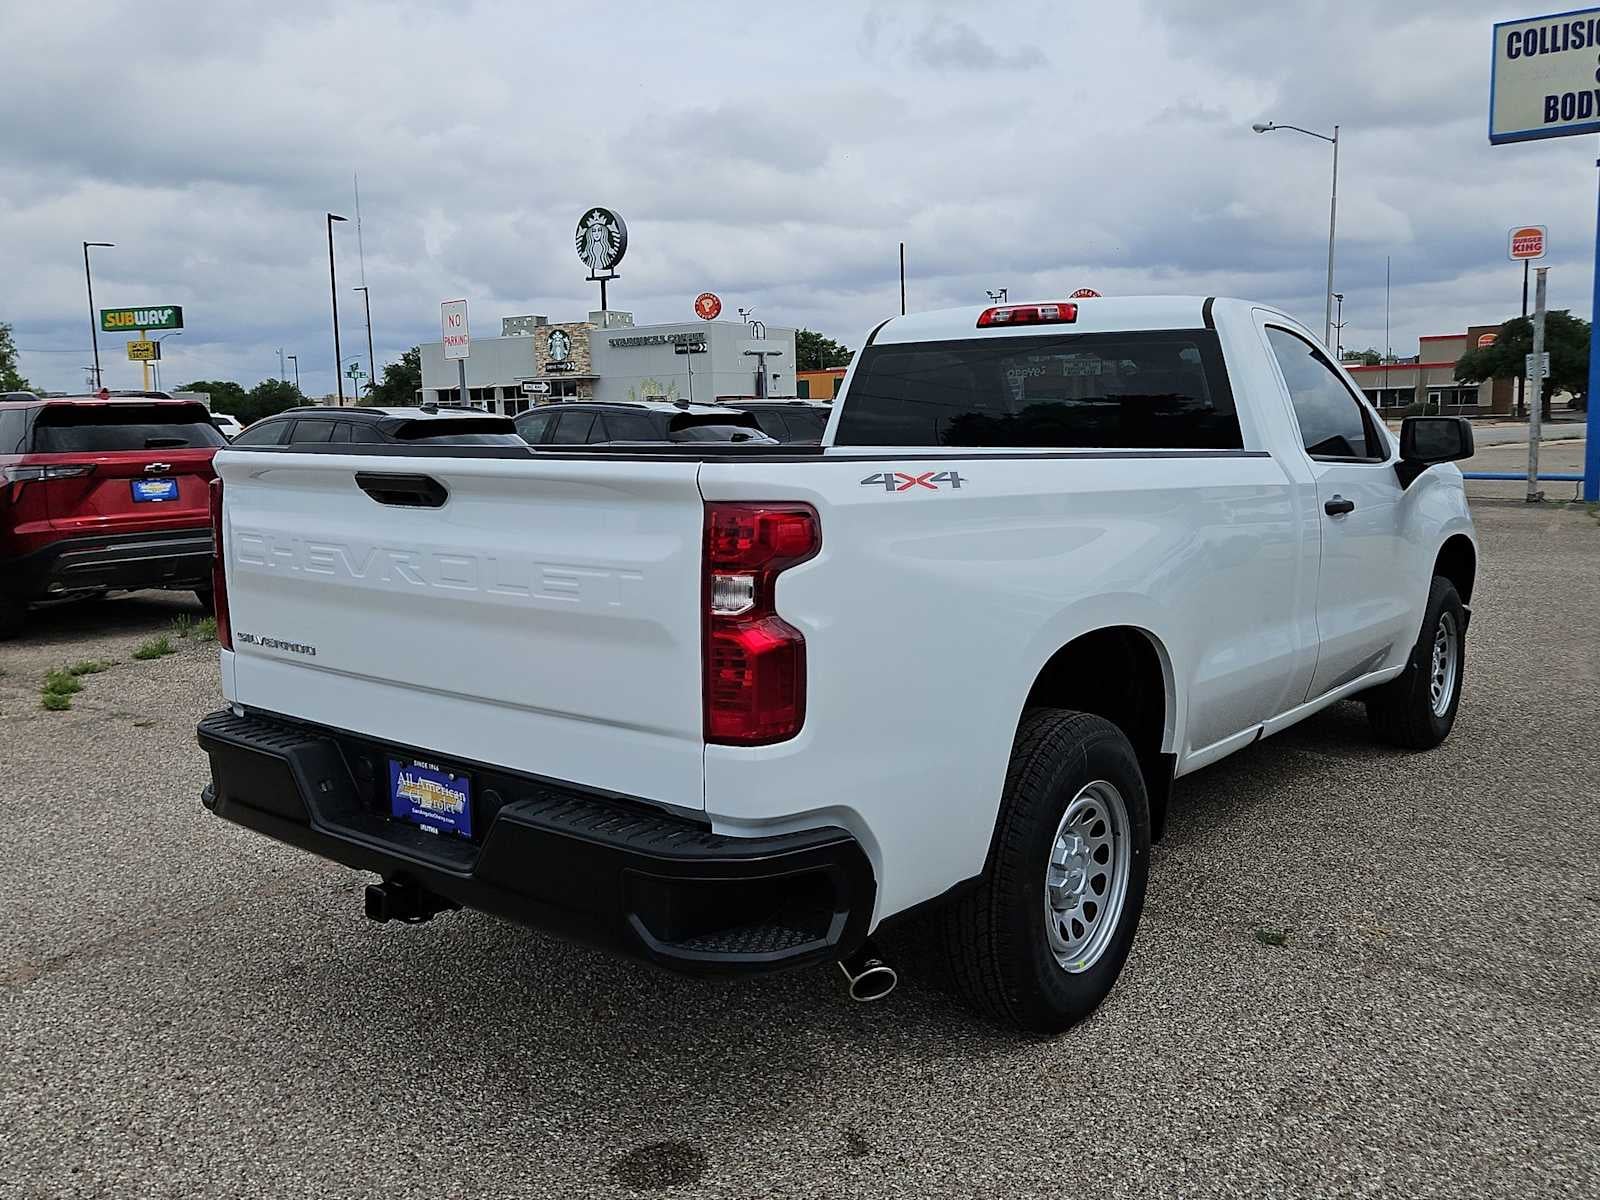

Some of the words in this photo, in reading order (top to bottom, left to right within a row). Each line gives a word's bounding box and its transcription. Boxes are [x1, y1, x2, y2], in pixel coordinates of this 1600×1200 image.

[1512, 243, 1542, 252] KING
[104, 309, 173, 328] SUBWAY
[448, 314, 461, 327] NO
[444, 335, 468, 346] PARKING
[237, 531, 644, 607] CHEVROLET
[237, 631, 316, 656] SILVERADO
[414, 760, 428, 769] SINCE
[398, 771, 413, 785] All
[417, 776, 467, 802] American
